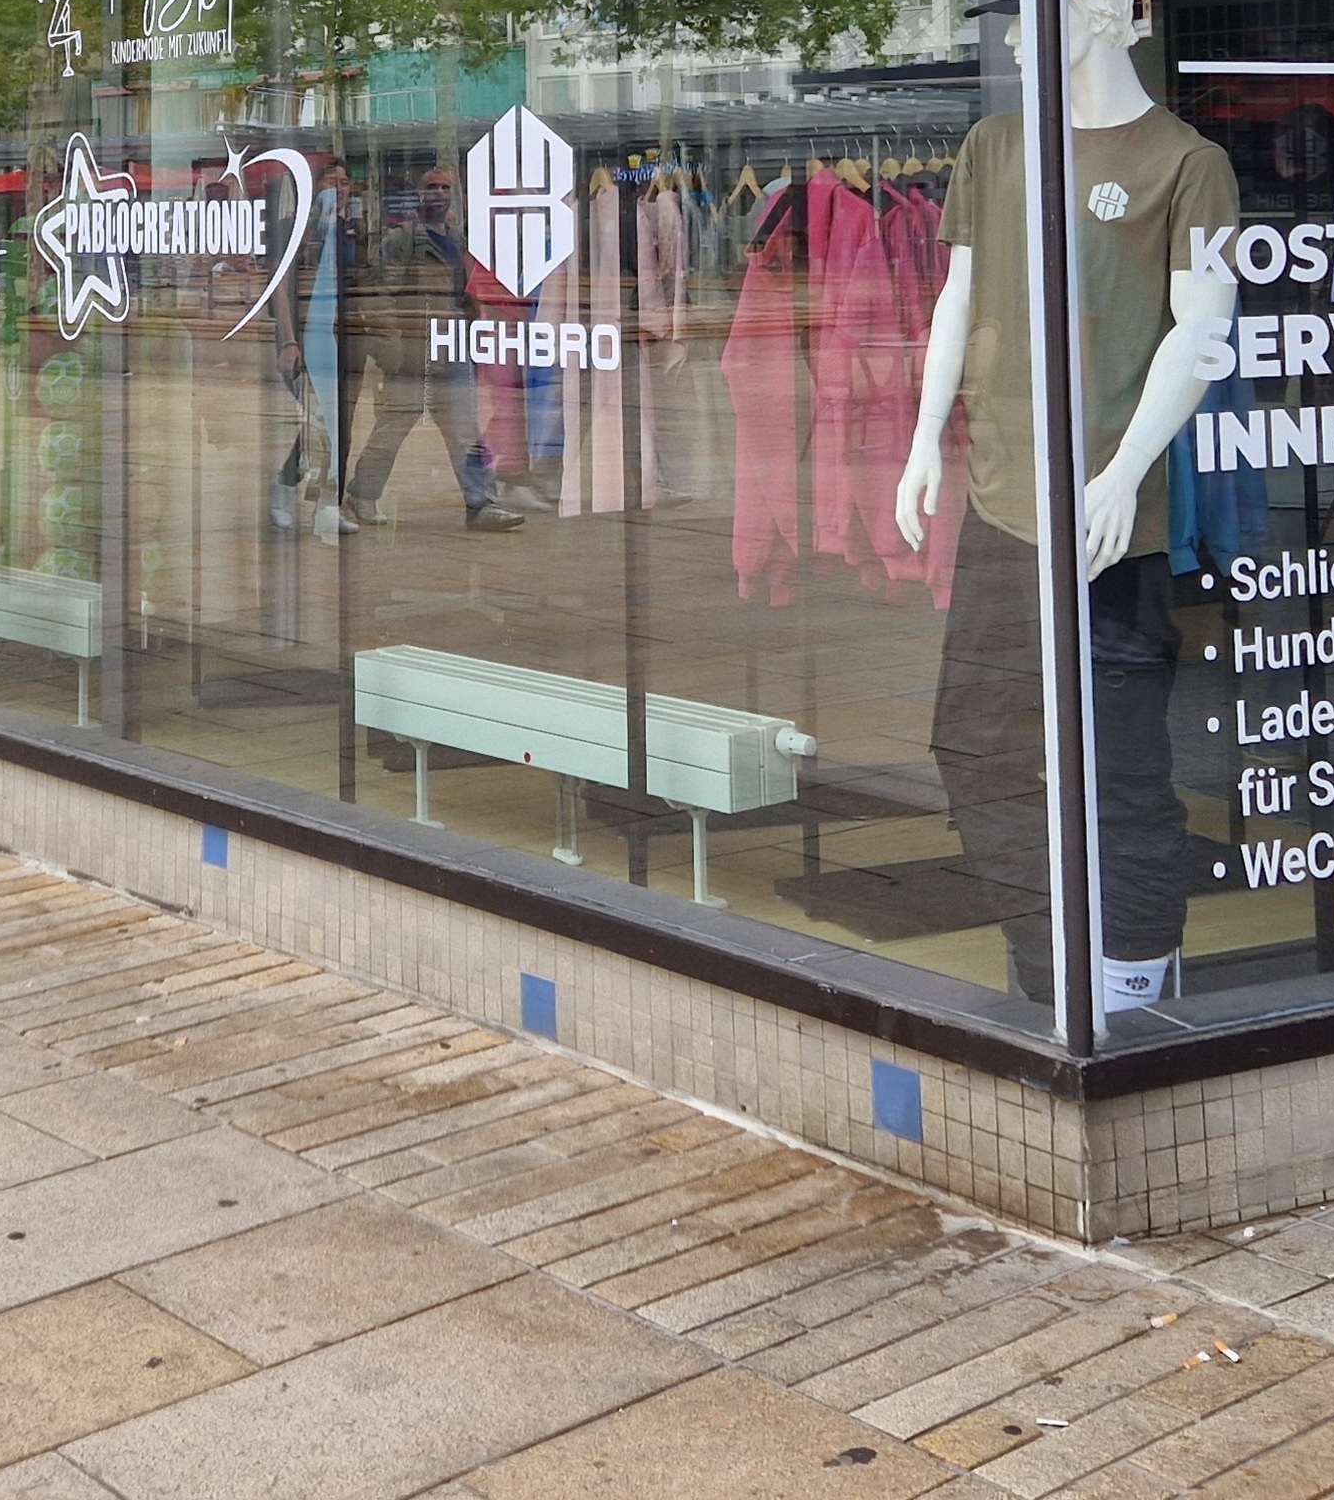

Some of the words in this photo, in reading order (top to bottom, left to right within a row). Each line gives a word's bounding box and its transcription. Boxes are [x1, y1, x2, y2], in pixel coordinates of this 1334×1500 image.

[111, 37, 165, 65] KINDERMODE
[168, 34, 183, 59] MIT
[187, 29, 227, 56] ZUKUNFT
[65, 199, 267, 255] PABLOCREATIONDE
[430, 317, 622, 371] HIGHBRO
[1237, 763, 1299, 818] für
